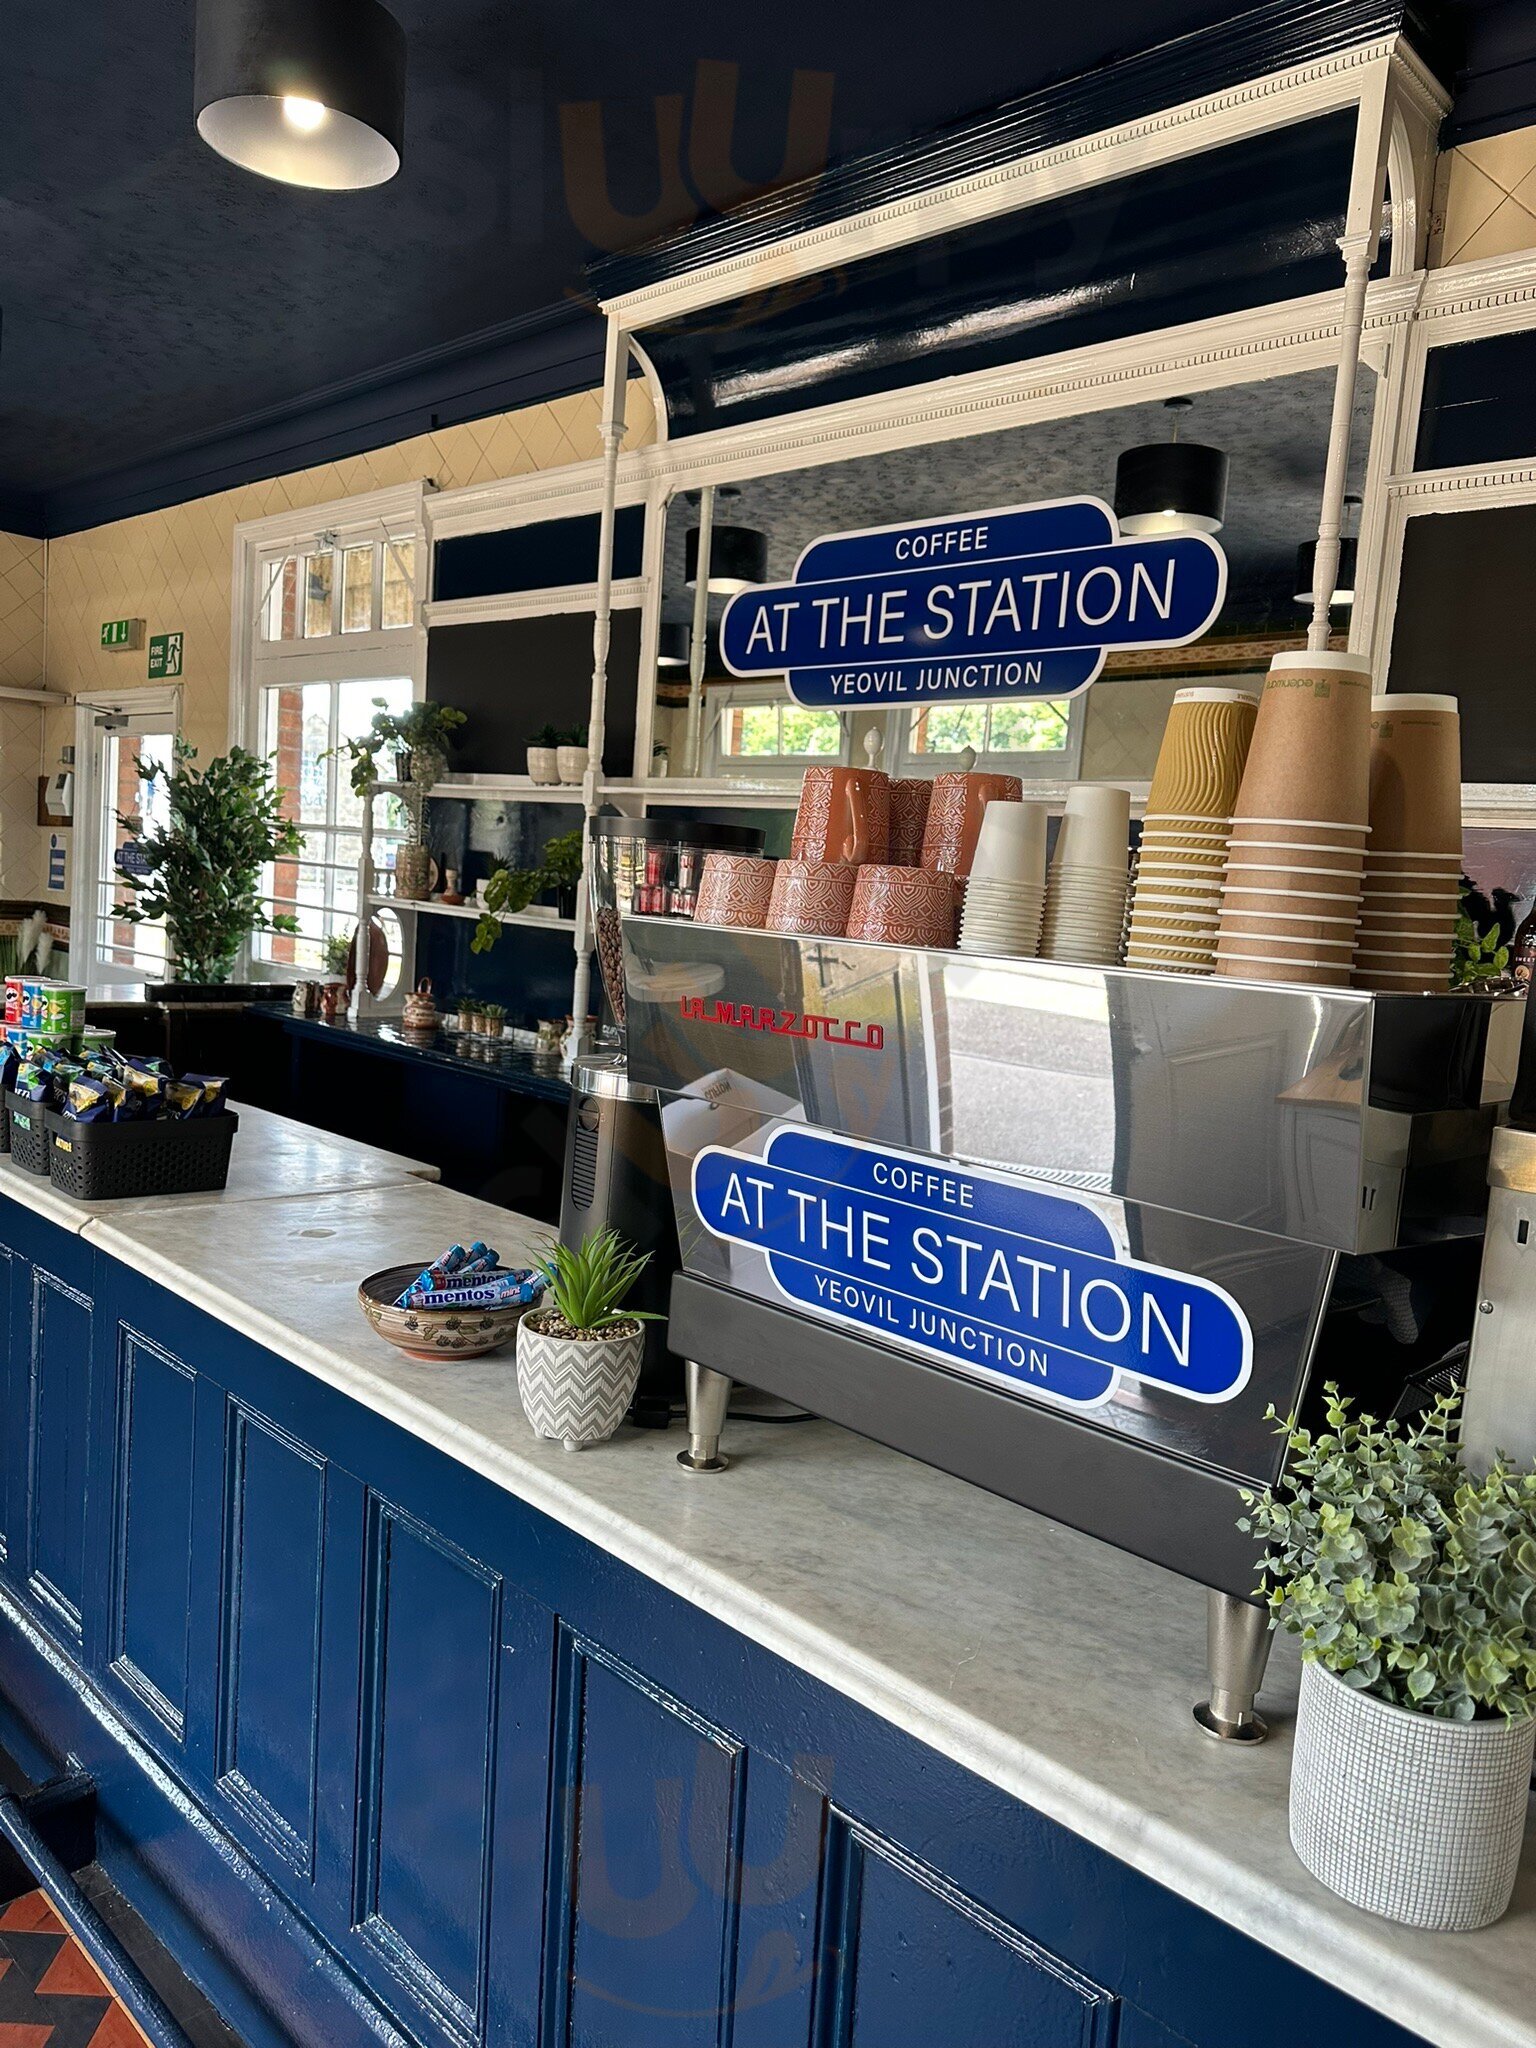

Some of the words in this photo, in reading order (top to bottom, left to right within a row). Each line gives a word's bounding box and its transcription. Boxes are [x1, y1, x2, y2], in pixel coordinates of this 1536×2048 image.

[895, 526, 988, 560] COFFEE
[746, 602, 799, 654] AT
[812, 590, 907, 649] THE
[922, 558, 1175, 640] STATION
[830, 671, 907, 696] YEOVIL
[916, 660, 1043, 691] JUNCTION
[681, 996, 705, 1019] LA
[873, 1162, 975, 1208] COFFEE
[720, 1172, 774, 1229] AT
[787, 1189, 891, 1270] THE
[911, 1227, 1191, 1367] STATION
[424, 1289, 495, 1305] mentos
[500, 1286, 521, 1299] mint
[814, 1275, 899, 1324] YEOVIL
[909, 1308, 1048, 1377] JUNCTION
